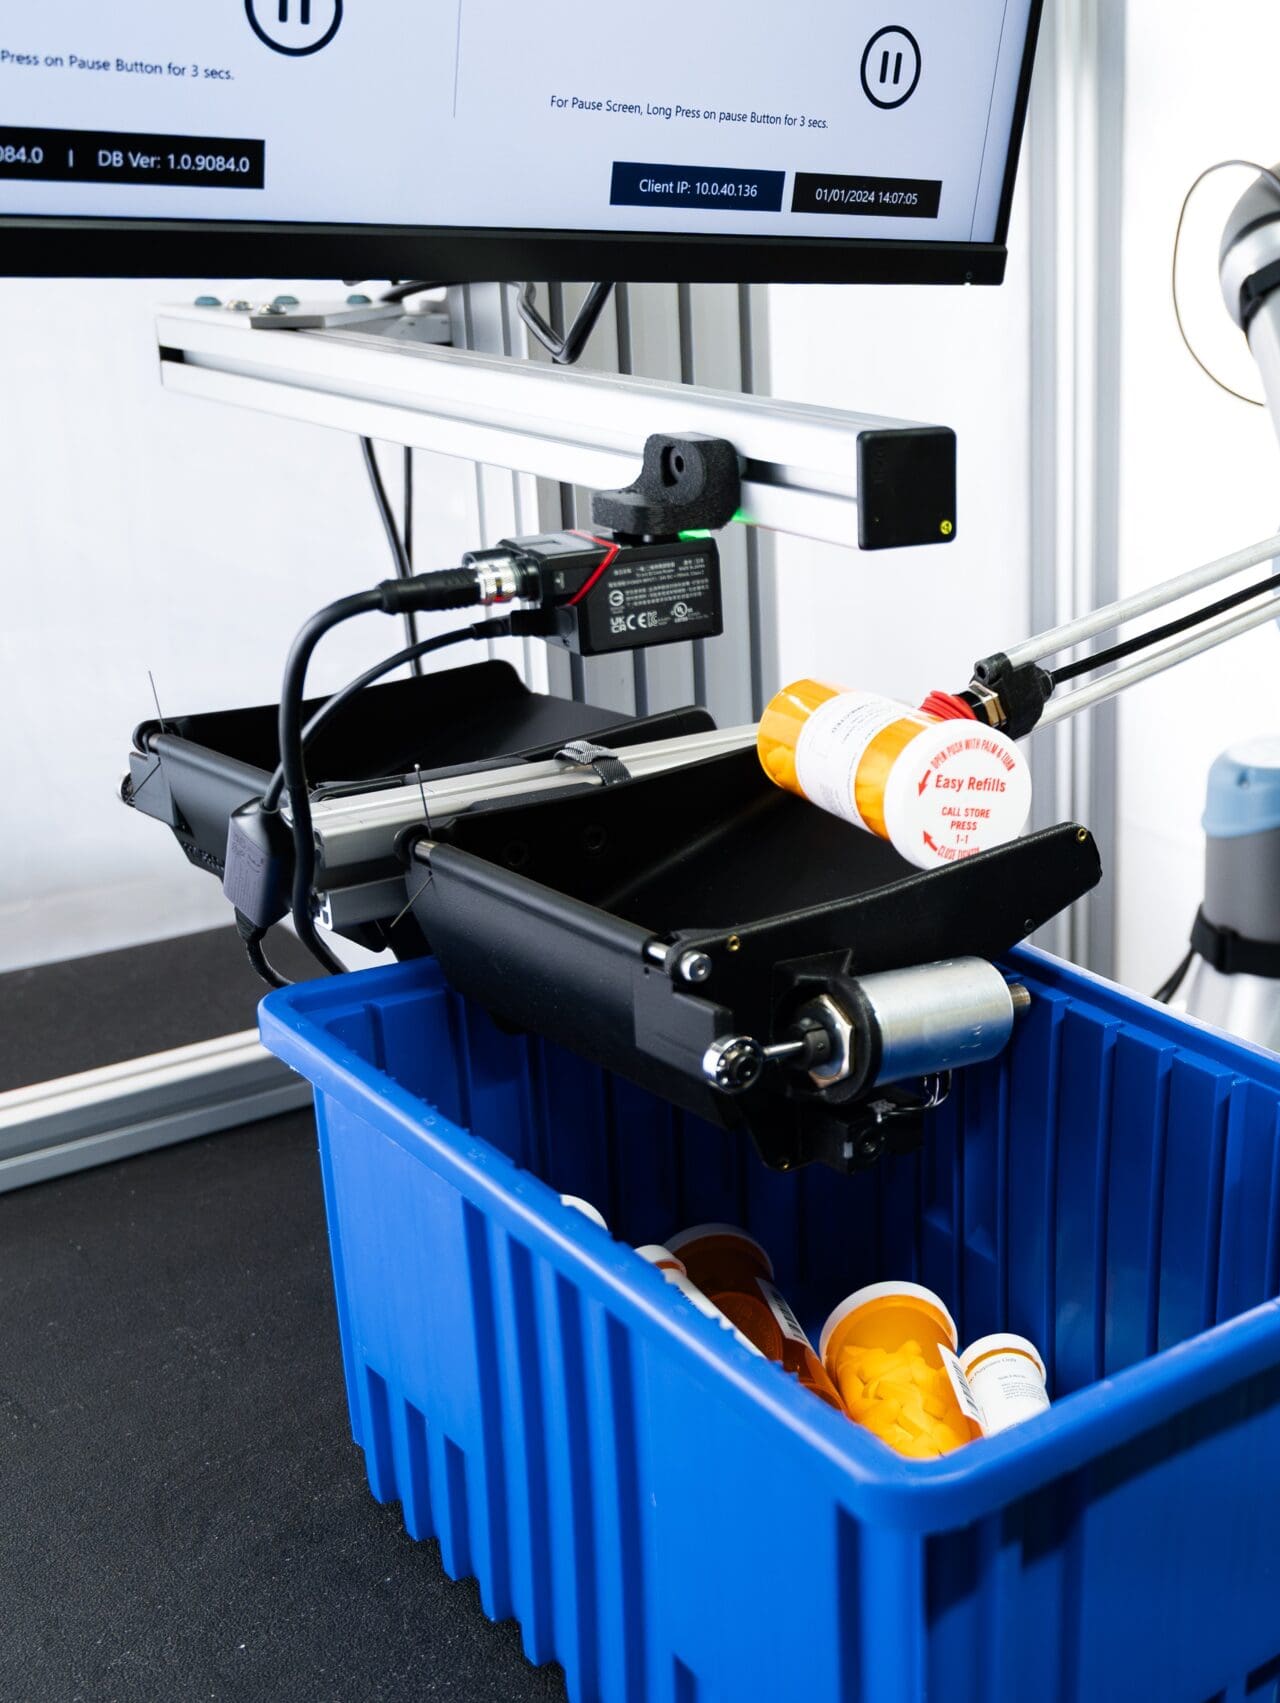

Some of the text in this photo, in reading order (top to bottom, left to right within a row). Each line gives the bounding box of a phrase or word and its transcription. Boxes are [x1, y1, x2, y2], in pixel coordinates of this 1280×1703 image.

[1, 50, 234, 80] Press on Pause Button for 3 secs.
[550, 95, 828, 129] For Pause Screen, Long Press on pause Button for 3 secs.
[98, 150, 123, 168] DB
[128, 151, 161, 170] Ver:
[167, 154, 250, 173] 1.0.9084.0
[639, 179, 758, 198] Client IP: 10.0.40.136
[815, 188, 919, 206] 01/01/2024 14:07:05
[935, 774, 1007, 793] Easy Refills
[941, 806, 991, 818] CALL STORE
[950, 820, 977, 831] PRESS
